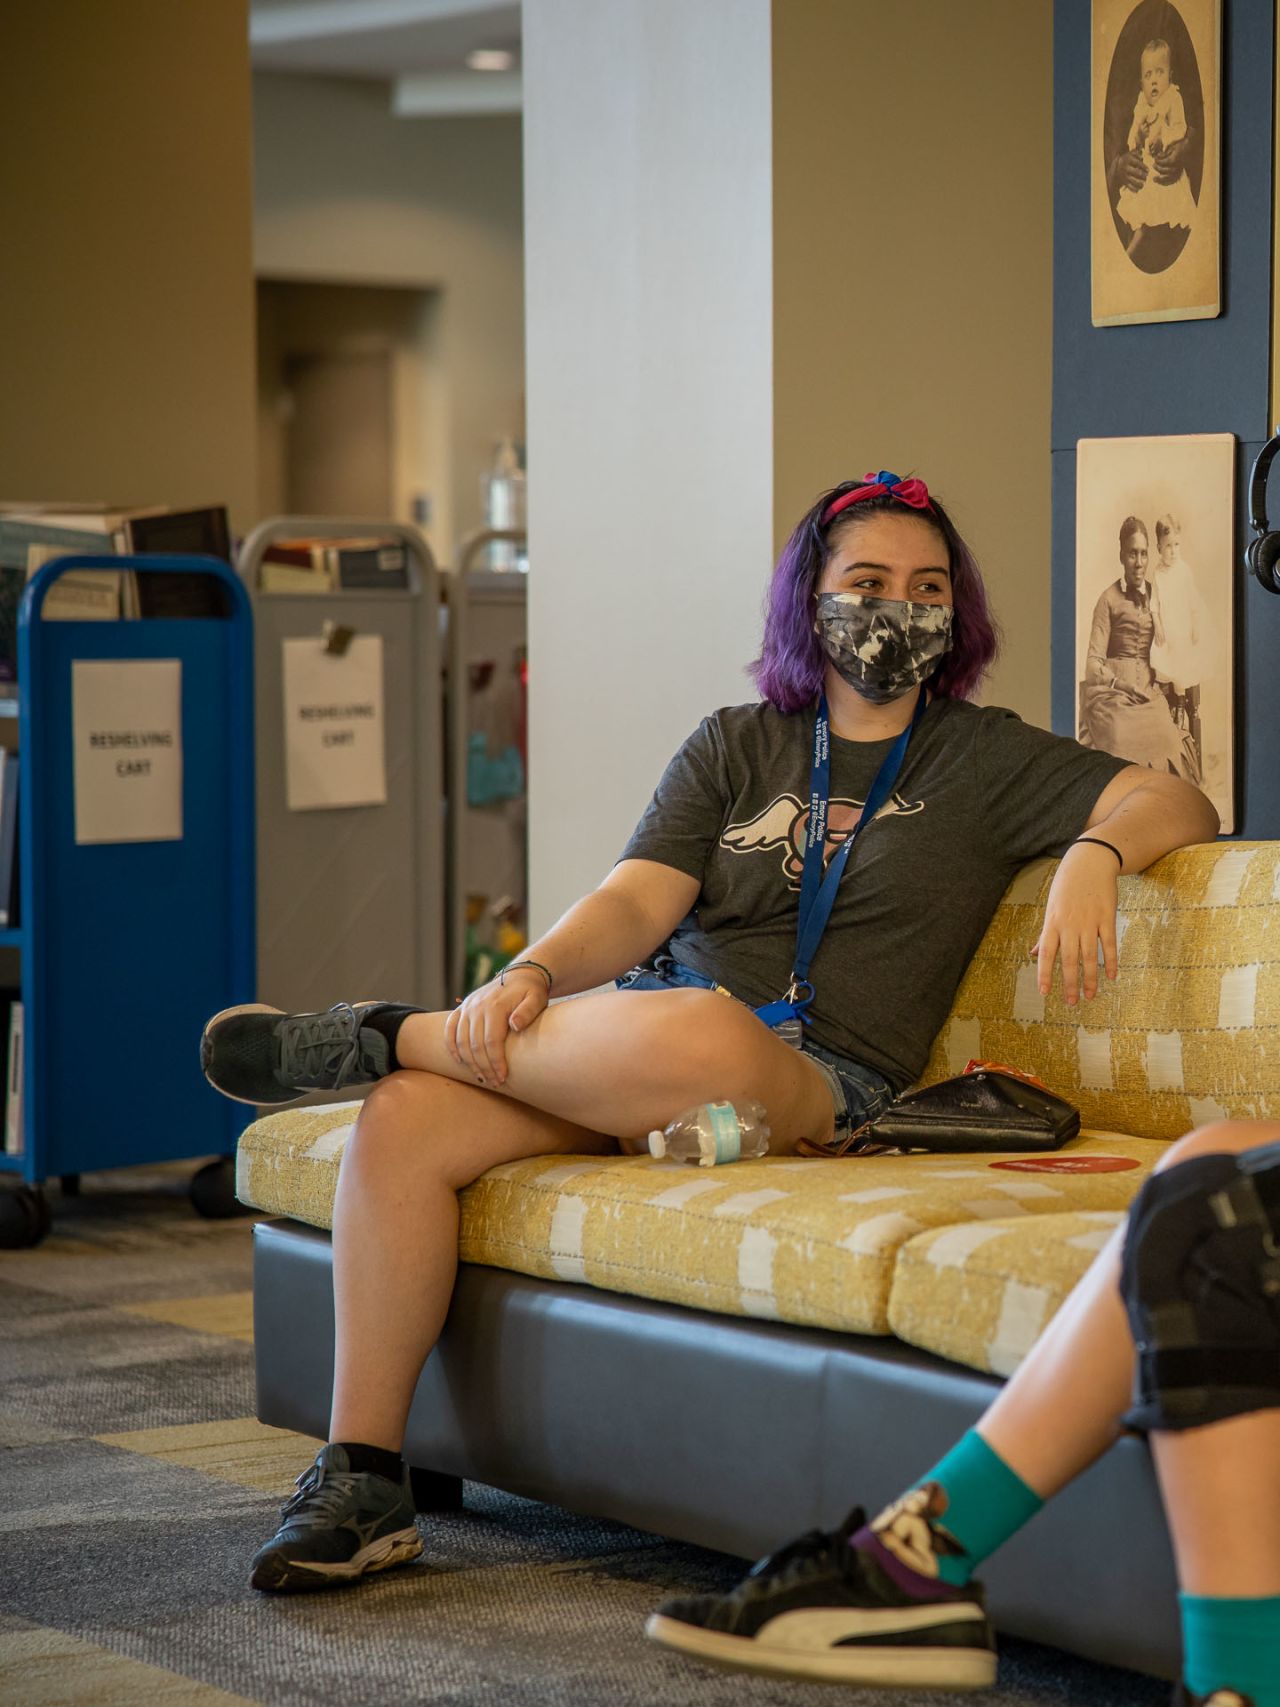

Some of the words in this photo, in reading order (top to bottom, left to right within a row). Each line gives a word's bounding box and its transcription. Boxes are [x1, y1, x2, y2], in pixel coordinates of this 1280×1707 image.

[90, 731, 173, 748] RESHELVING
[322, 731, 354, 748] CART
[116, 759, 151, 777] CART
[818, 800, 827, 820] Emory
[816, 821, 825, 842] Police
